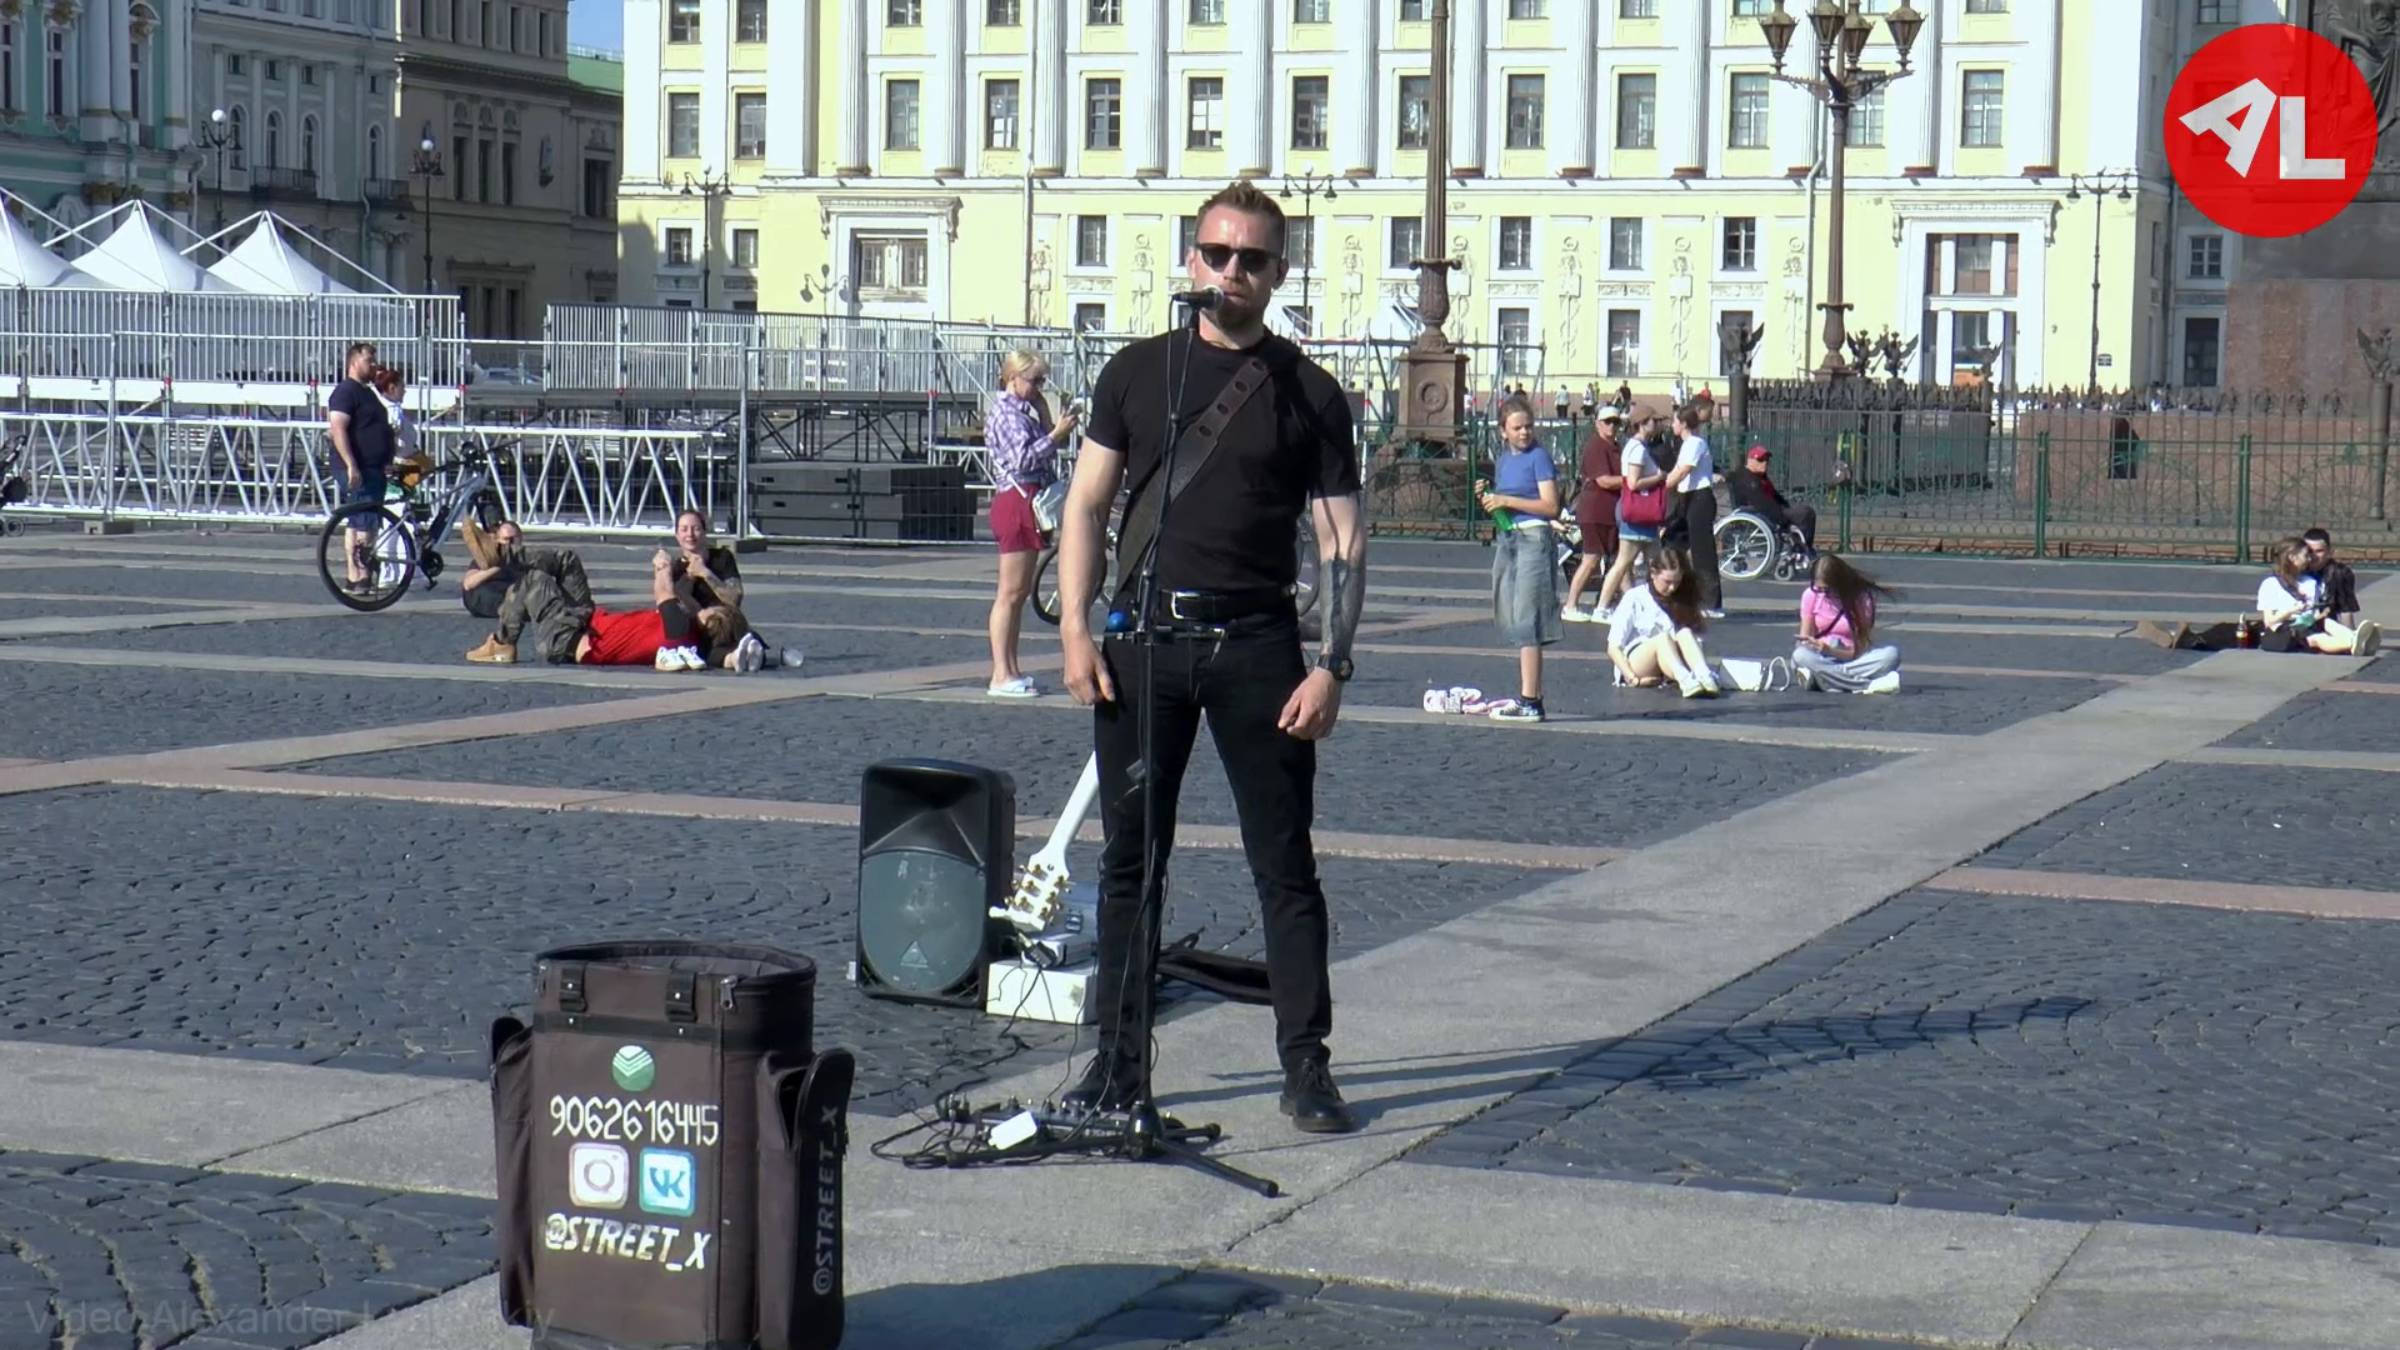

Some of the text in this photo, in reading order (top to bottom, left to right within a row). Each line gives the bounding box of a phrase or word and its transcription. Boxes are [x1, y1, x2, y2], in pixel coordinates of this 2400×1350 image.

[550, 1095, 719, 1146] 9062616445
[812, 1105, 838, 1295] @STREET_X
[545, 1213, 711, 1271] @STREET_X
